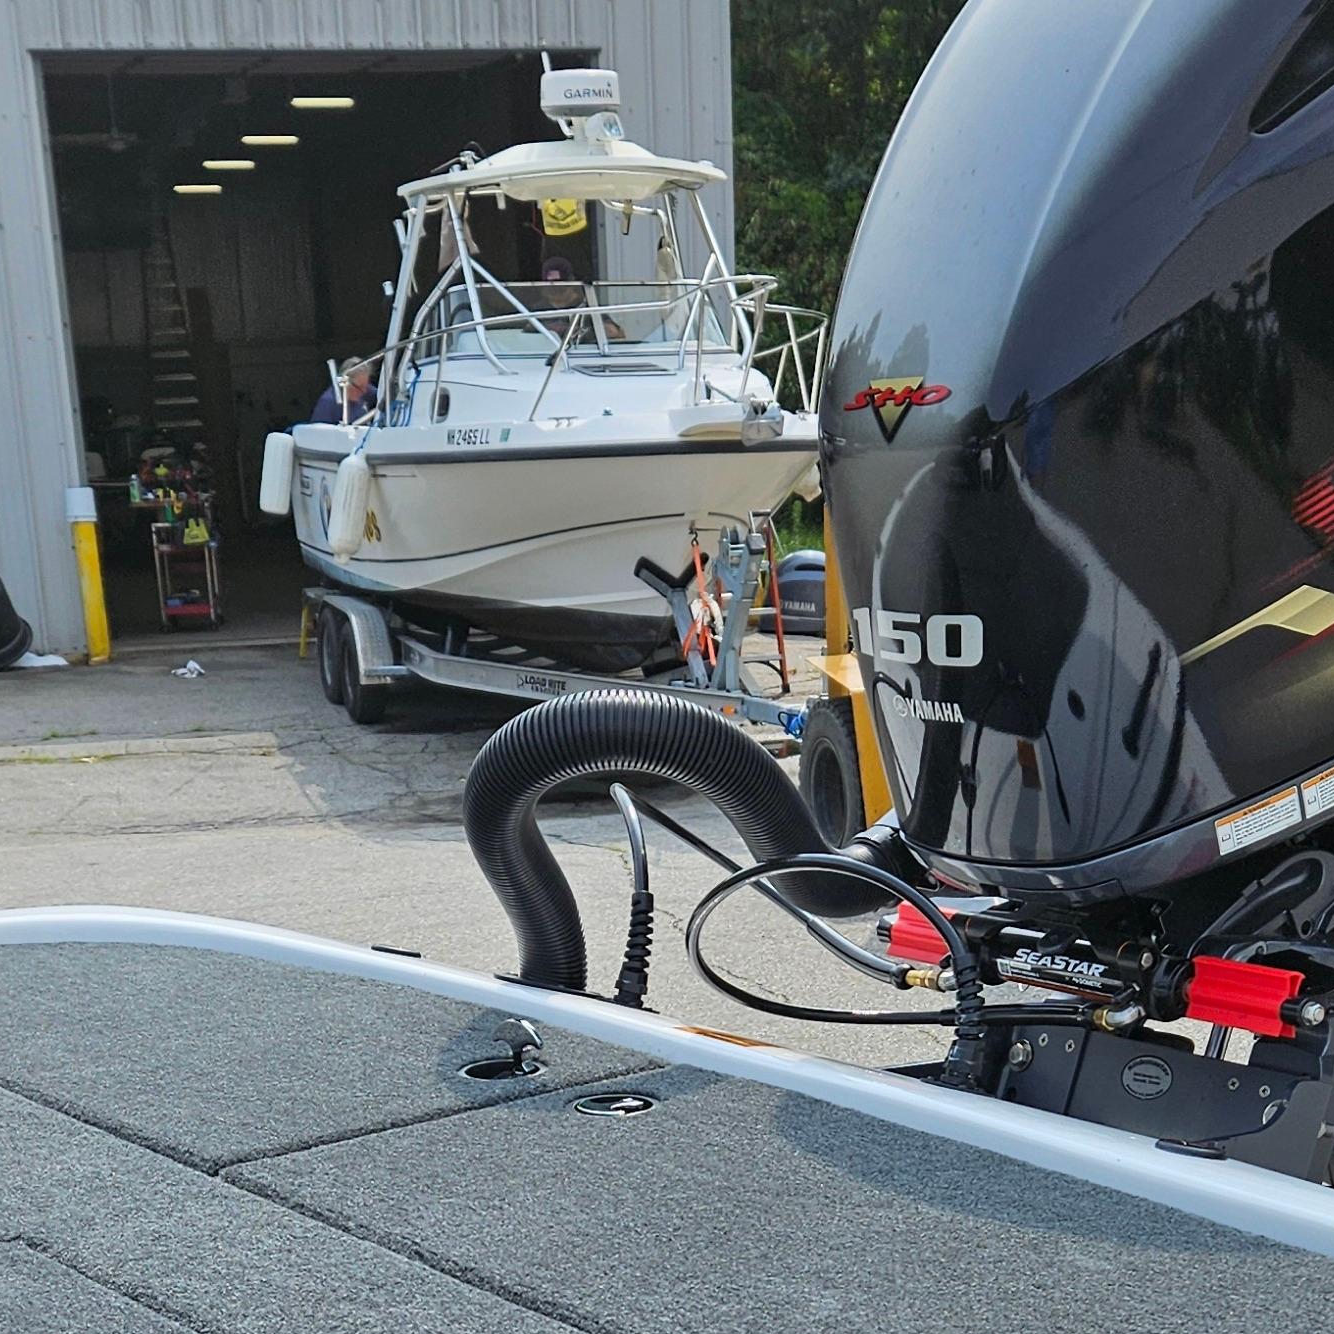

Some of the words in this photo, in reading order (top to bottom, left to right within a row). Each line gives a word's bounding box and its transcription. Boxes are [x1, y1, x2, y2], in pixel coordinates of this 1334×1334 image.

[564, 88, 613, 99] GARMIN
[843, 384, 953, 411] SHO
[784, 600, 816, 612] YAMAHA
[852, 606, 984, 667] 150
[906, 697, 965, 723] YAMAHA
[1013, 947, 1106, 978] SEASTAR
